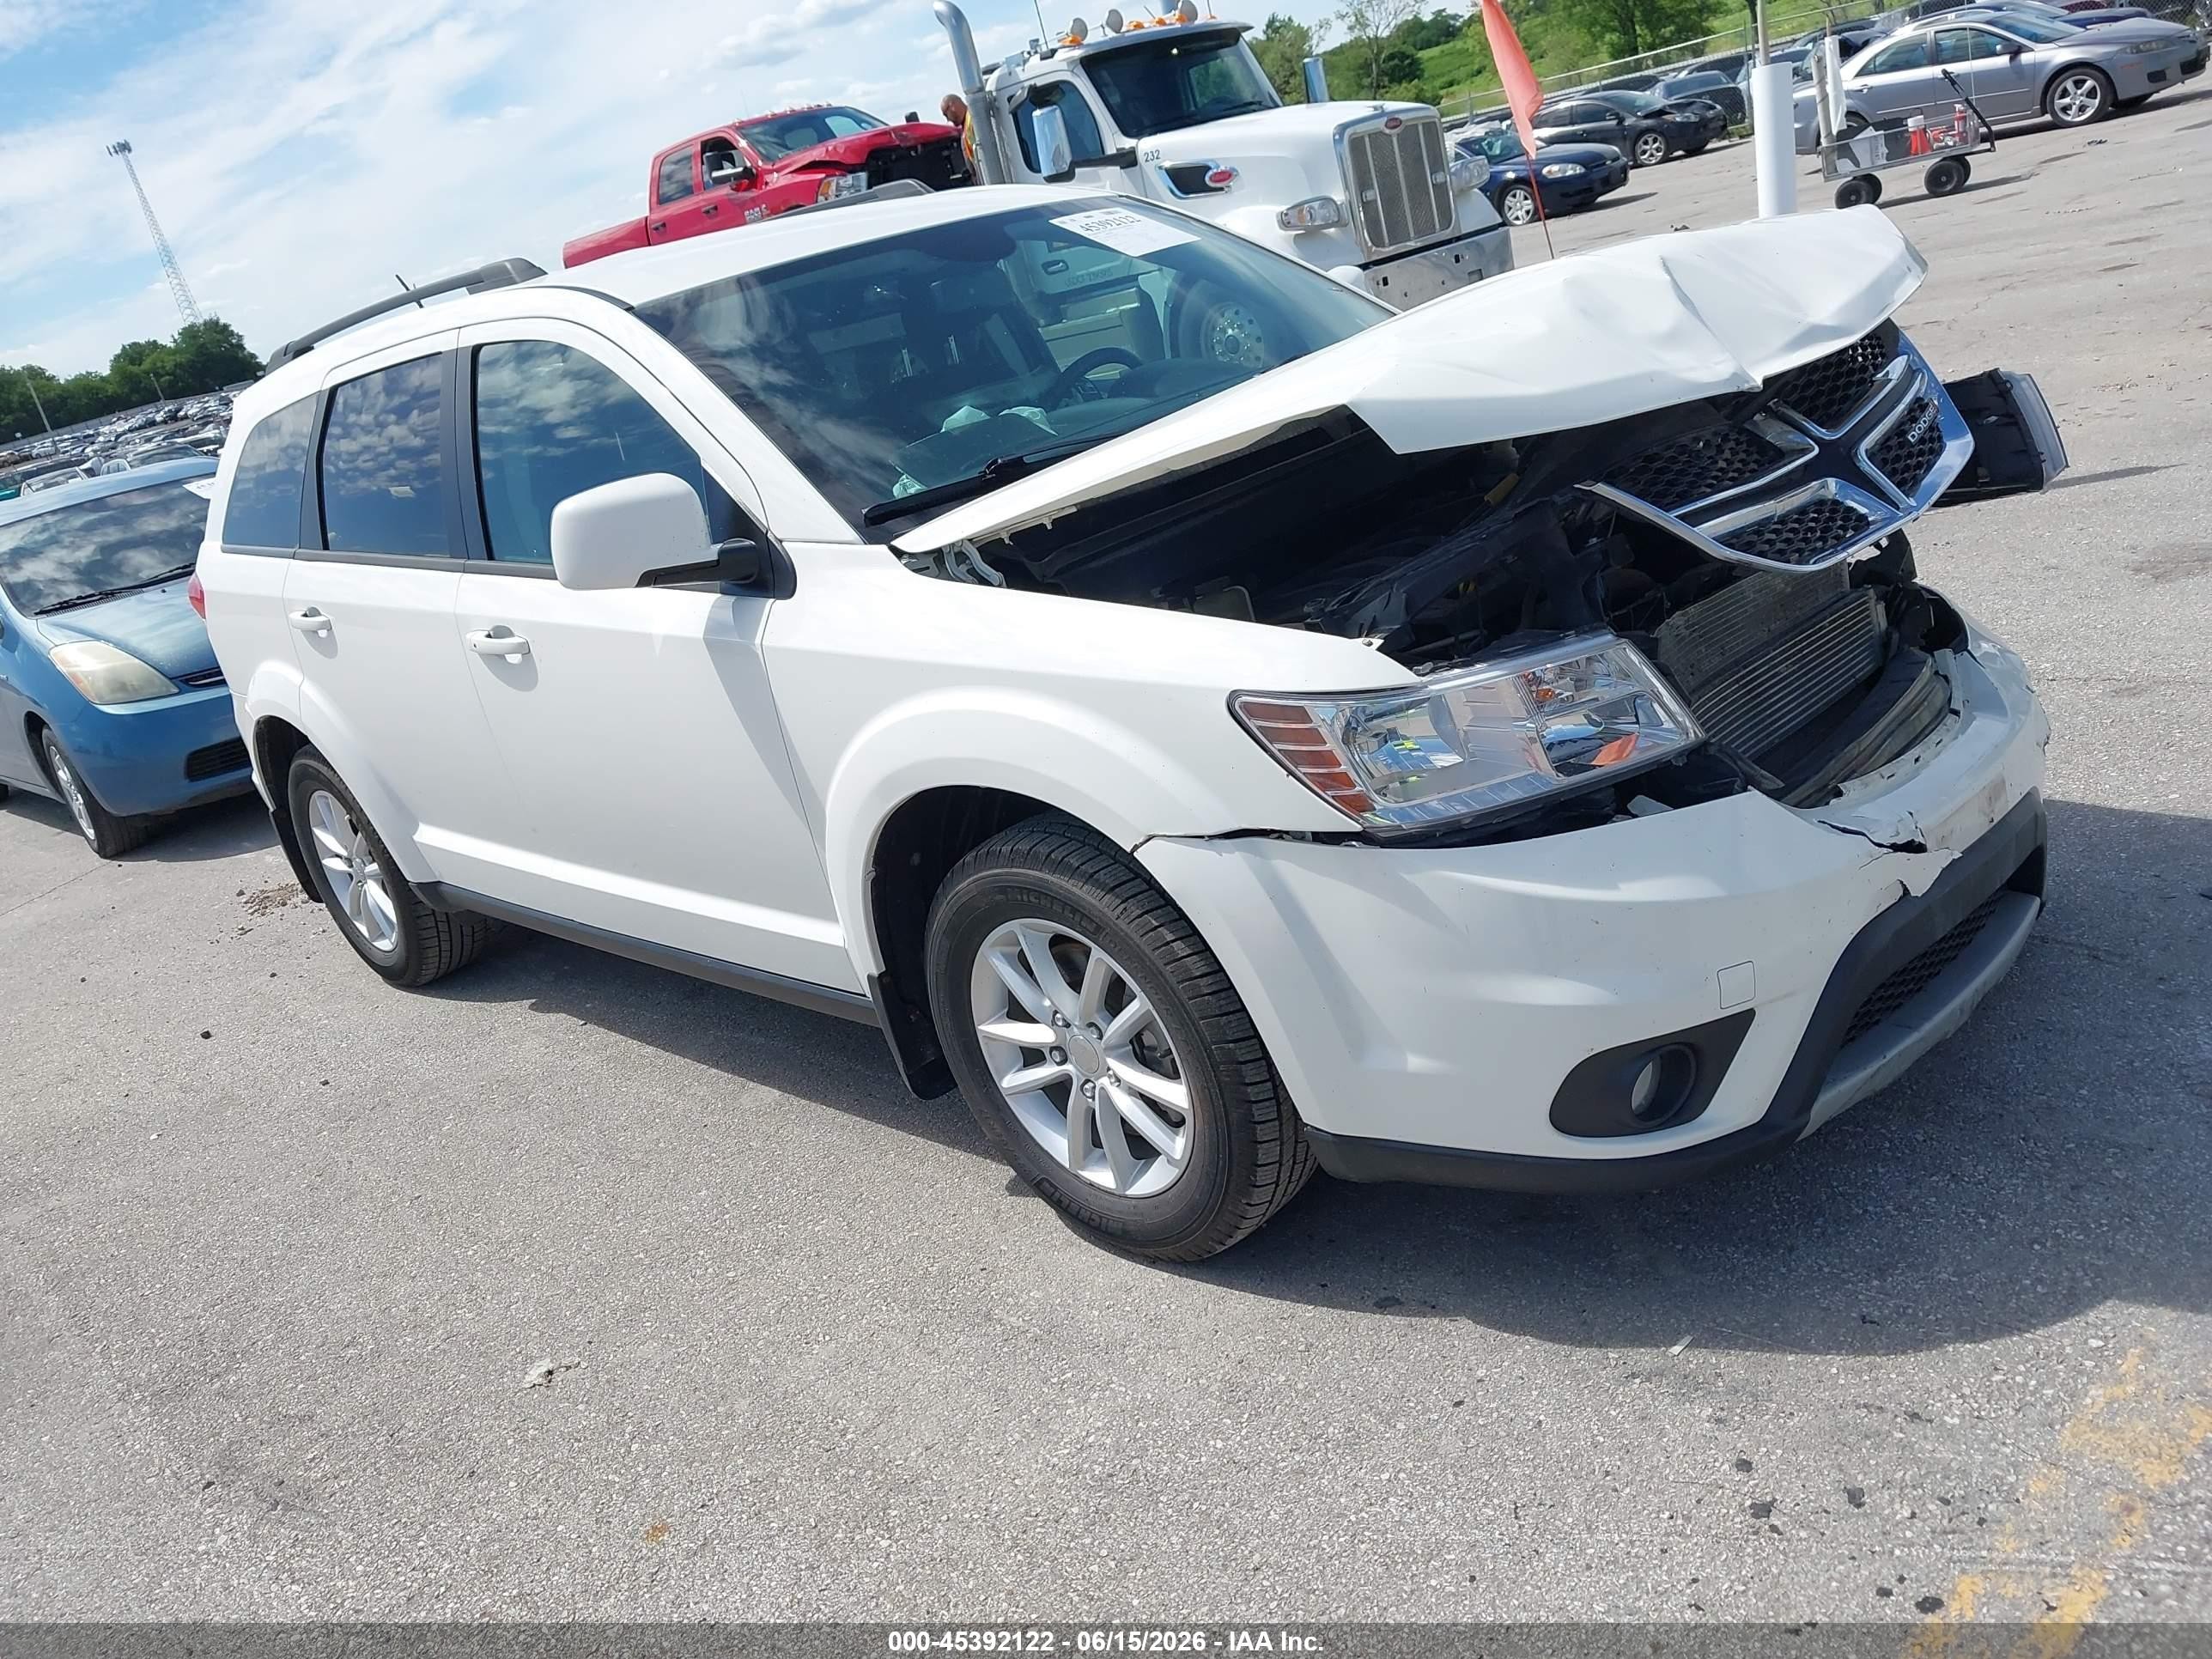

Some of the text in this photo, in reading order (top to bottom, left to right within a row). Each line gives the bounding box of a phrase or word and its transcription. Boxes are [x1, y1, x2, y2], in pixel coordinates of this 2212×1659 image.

[1144, 149, 1161, 162] 232
[1079, 215, 1141, 233] 45392122
[1907, 403, 1937, 443] DODGE
[1006, 890, 1100, 934] MICHELIN
